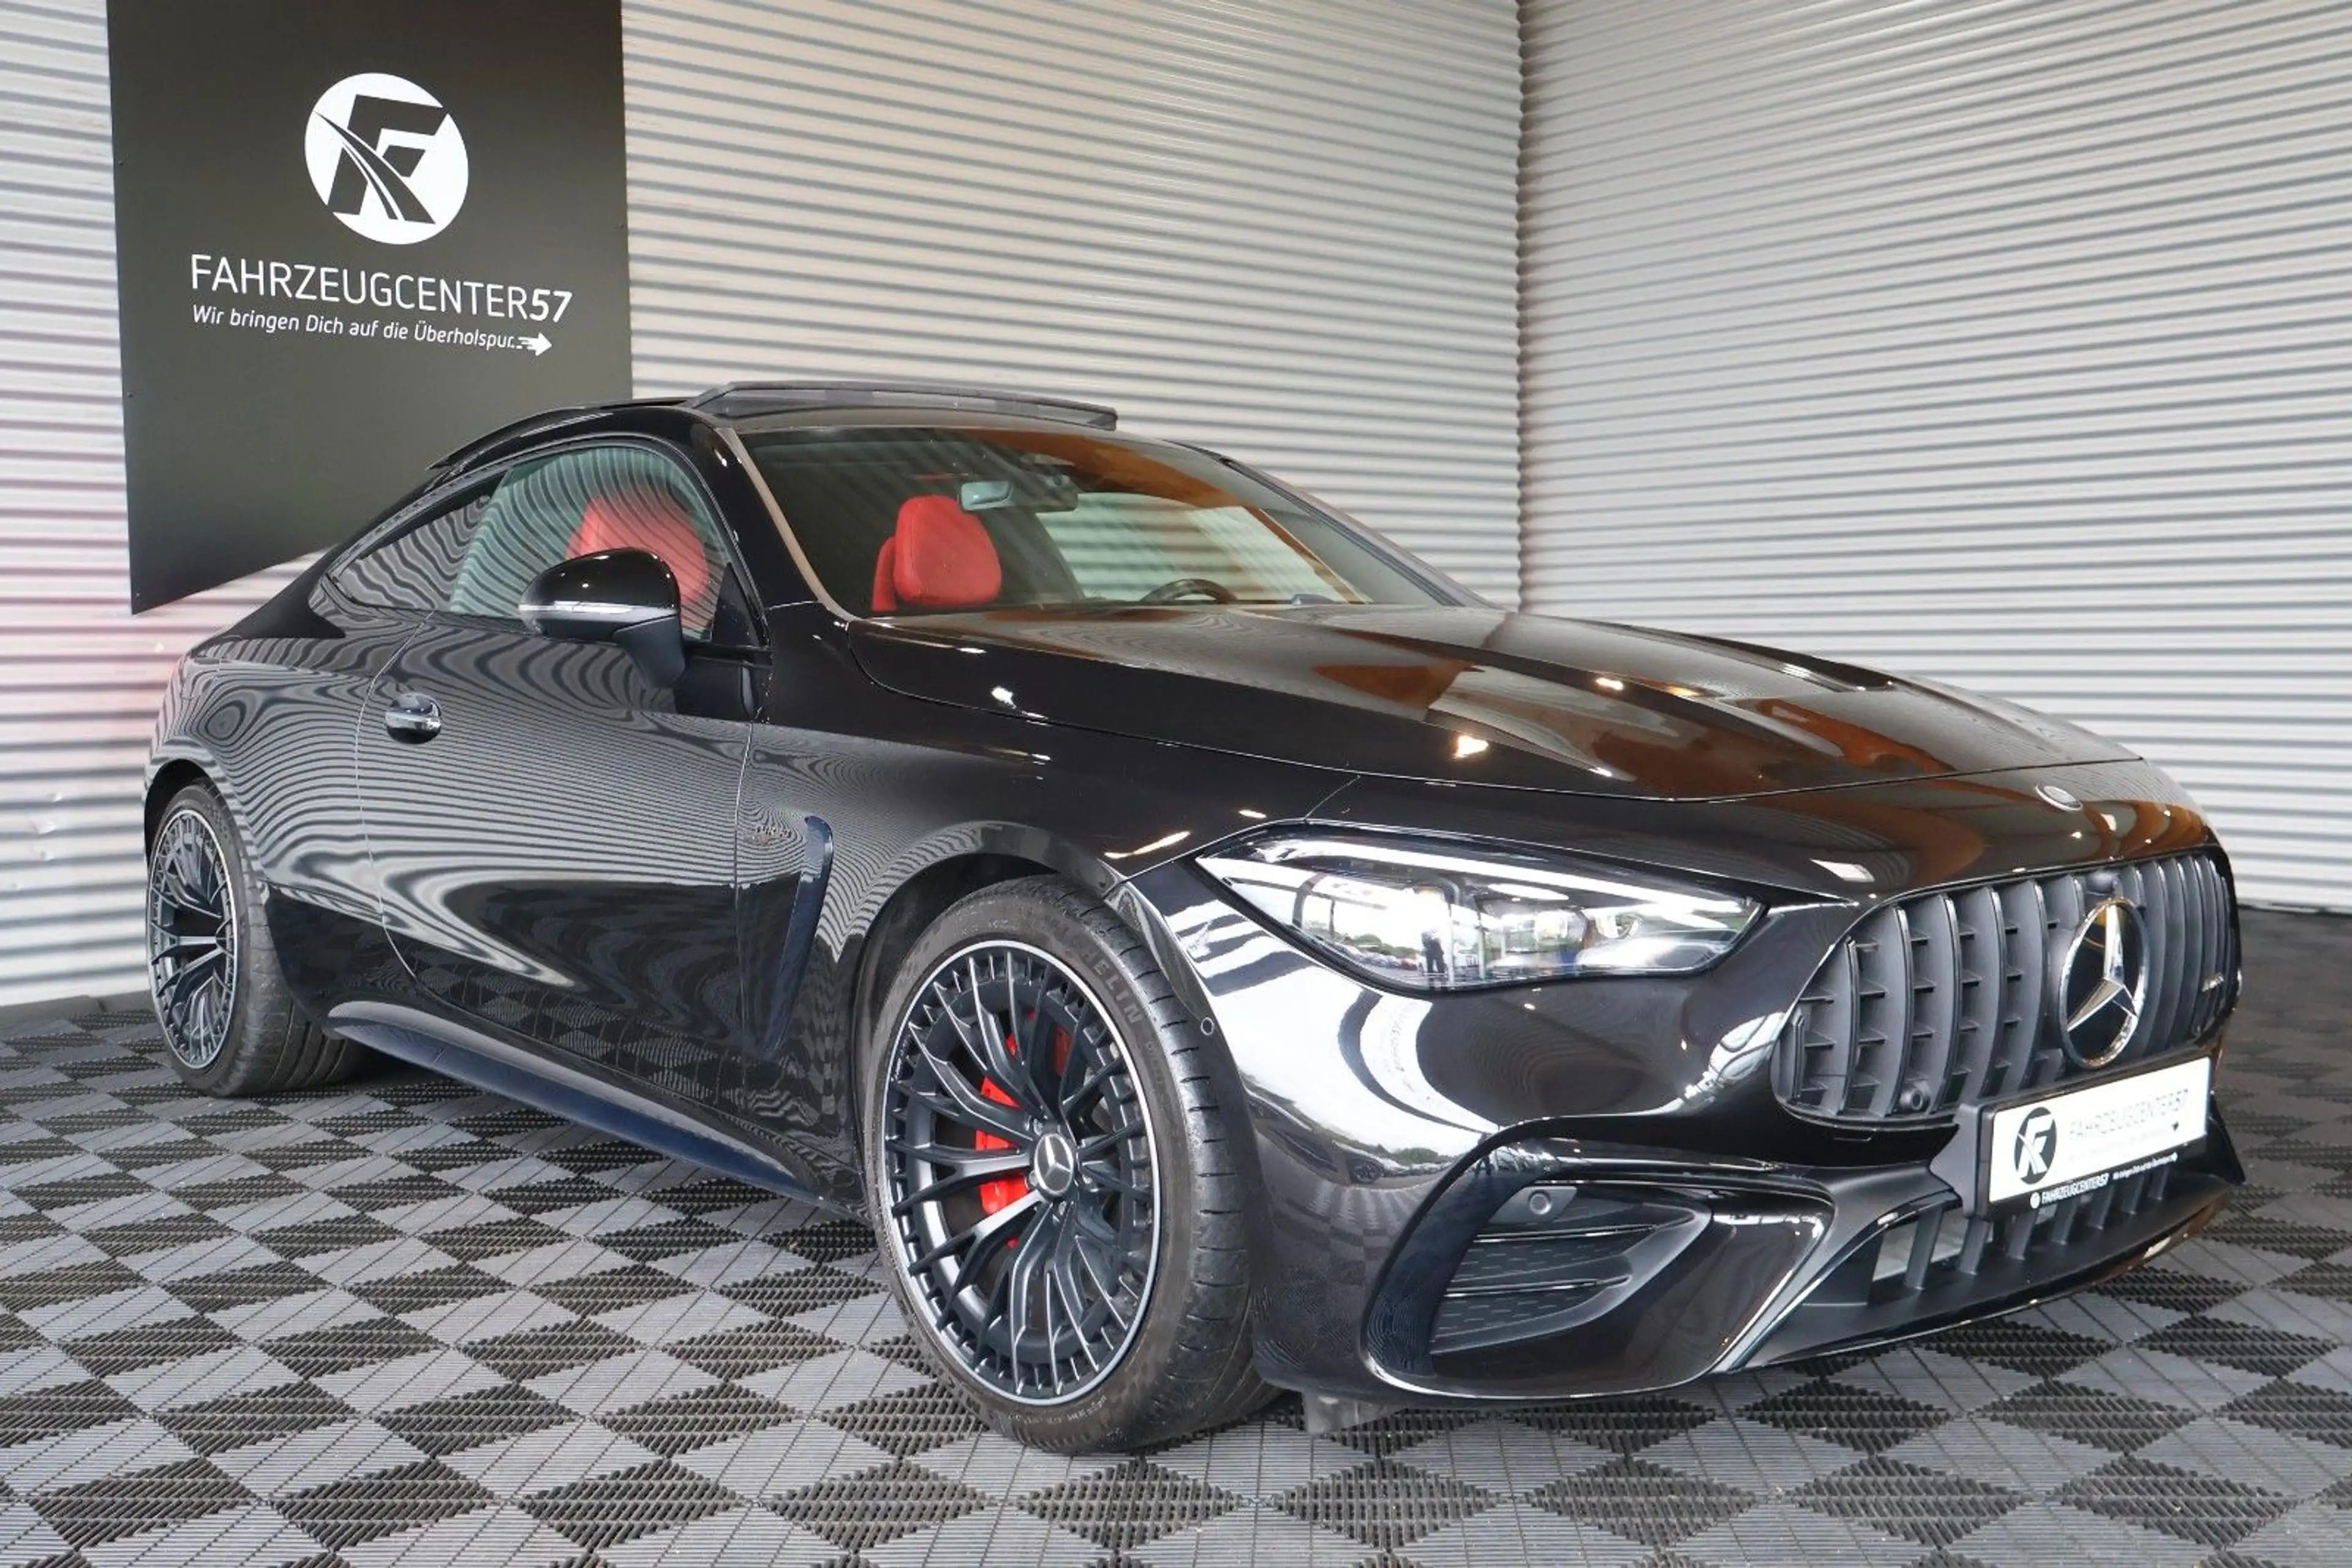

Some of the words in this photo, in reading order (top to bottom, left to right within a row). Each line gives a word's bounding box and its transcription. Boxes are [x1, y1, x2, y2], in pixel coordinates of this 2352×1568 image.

[191, 254, 573, 324] FAHRZEUGCENTER57
[193, 303, 225, 325] Wir
[229, 307, 300, 334] bringen
[305, 314, 344, 335] Dich
[348, 320, 380, 337] auf
[383, 322, 409, 340] die
[2069, 1088, 2189, 1140] FAHRZEUGCENTER57
